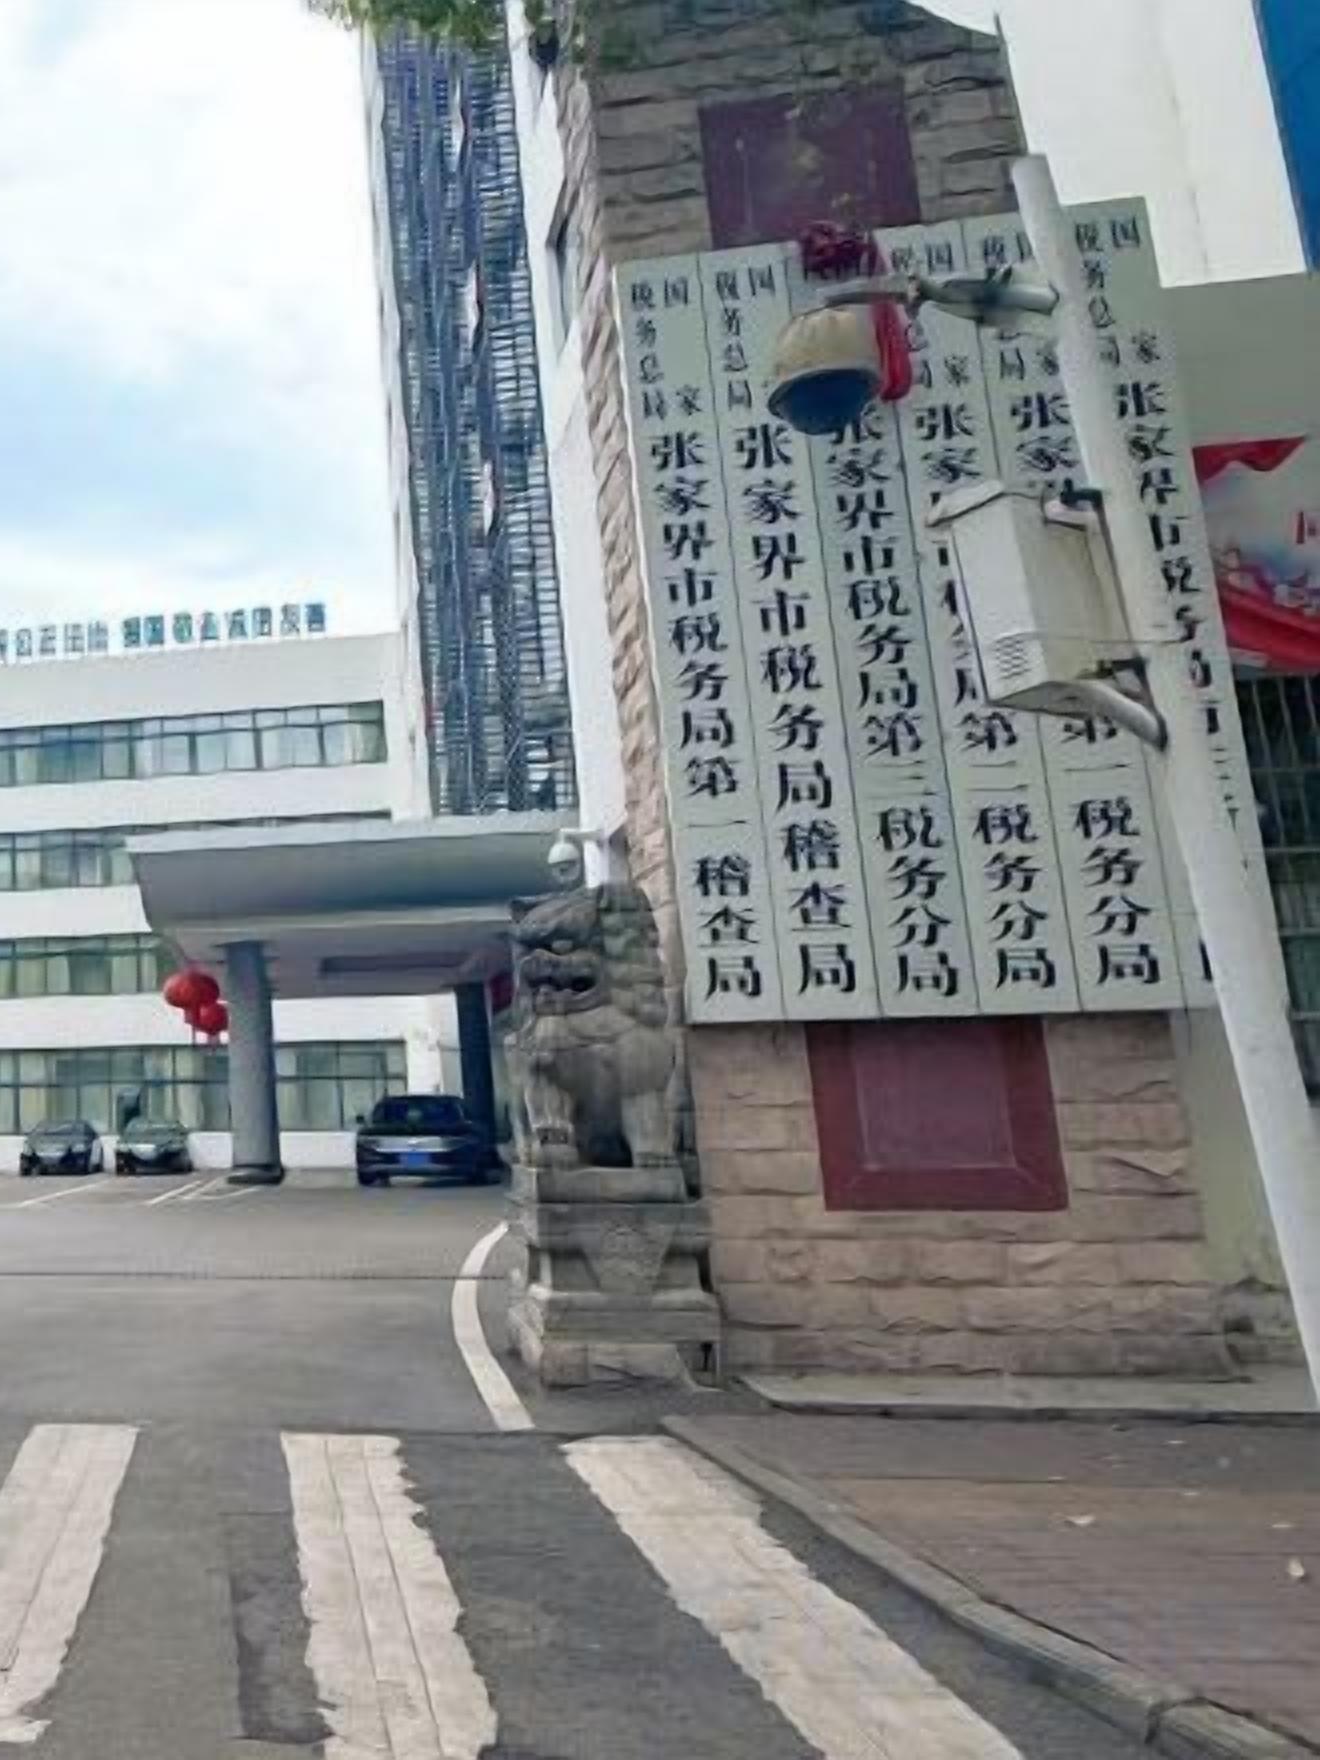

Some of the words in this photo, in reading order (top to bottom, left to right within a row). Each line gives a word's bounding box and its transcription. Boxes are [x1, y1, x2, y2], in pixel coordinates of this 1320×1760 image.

[650, 431, 762, 1001] 张家界市税务局第一稽查局
[733, 423, 857, 996] 张家界市税务局稽查局
[914, 401, 1057, 990] 张家第二税务分局
[1010, 390, 1161, 986] 张家第一税务分局
